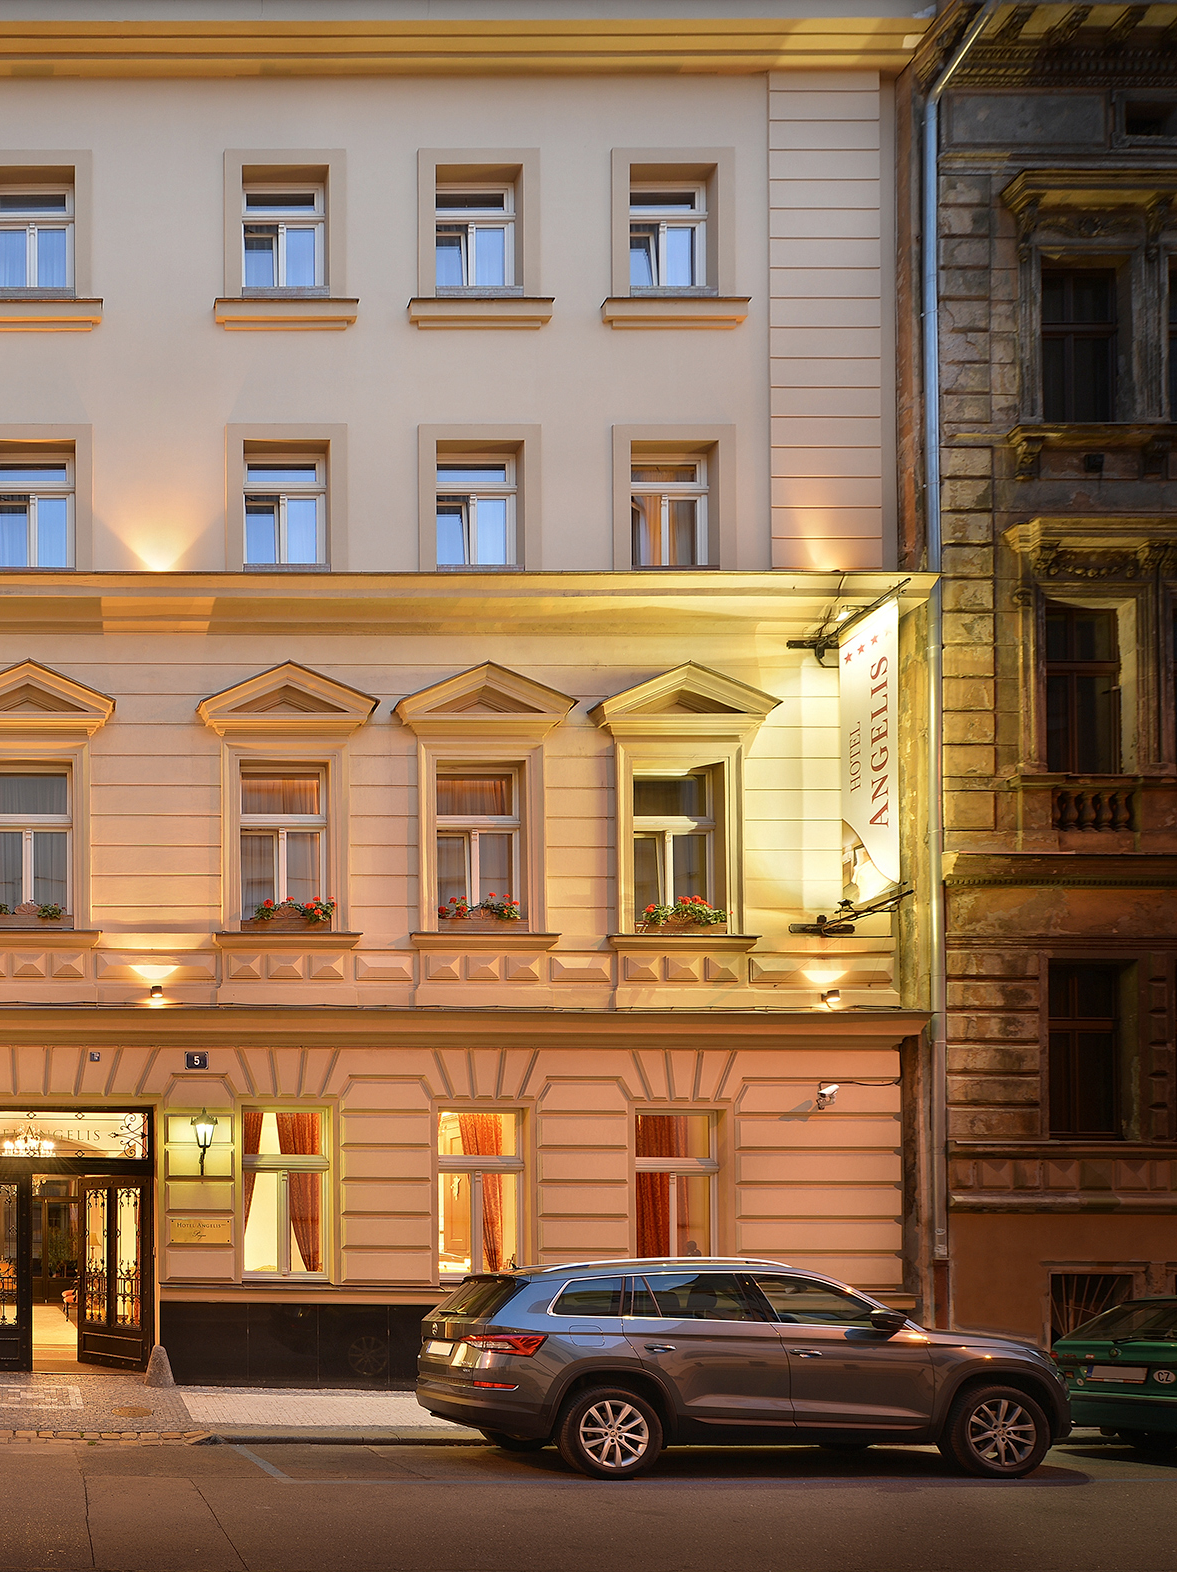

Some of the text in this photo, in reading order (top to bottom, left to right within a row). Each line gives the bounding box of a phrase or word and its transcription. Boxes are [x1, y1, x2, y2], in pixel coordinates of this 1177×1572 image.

[849, 721, 862, 793] HOTEL
[869, 655, 889, 828] ANGELIS
[193, 1055, 200, 1065] 5
[1157, 1371, 1172, 1382] CZ
